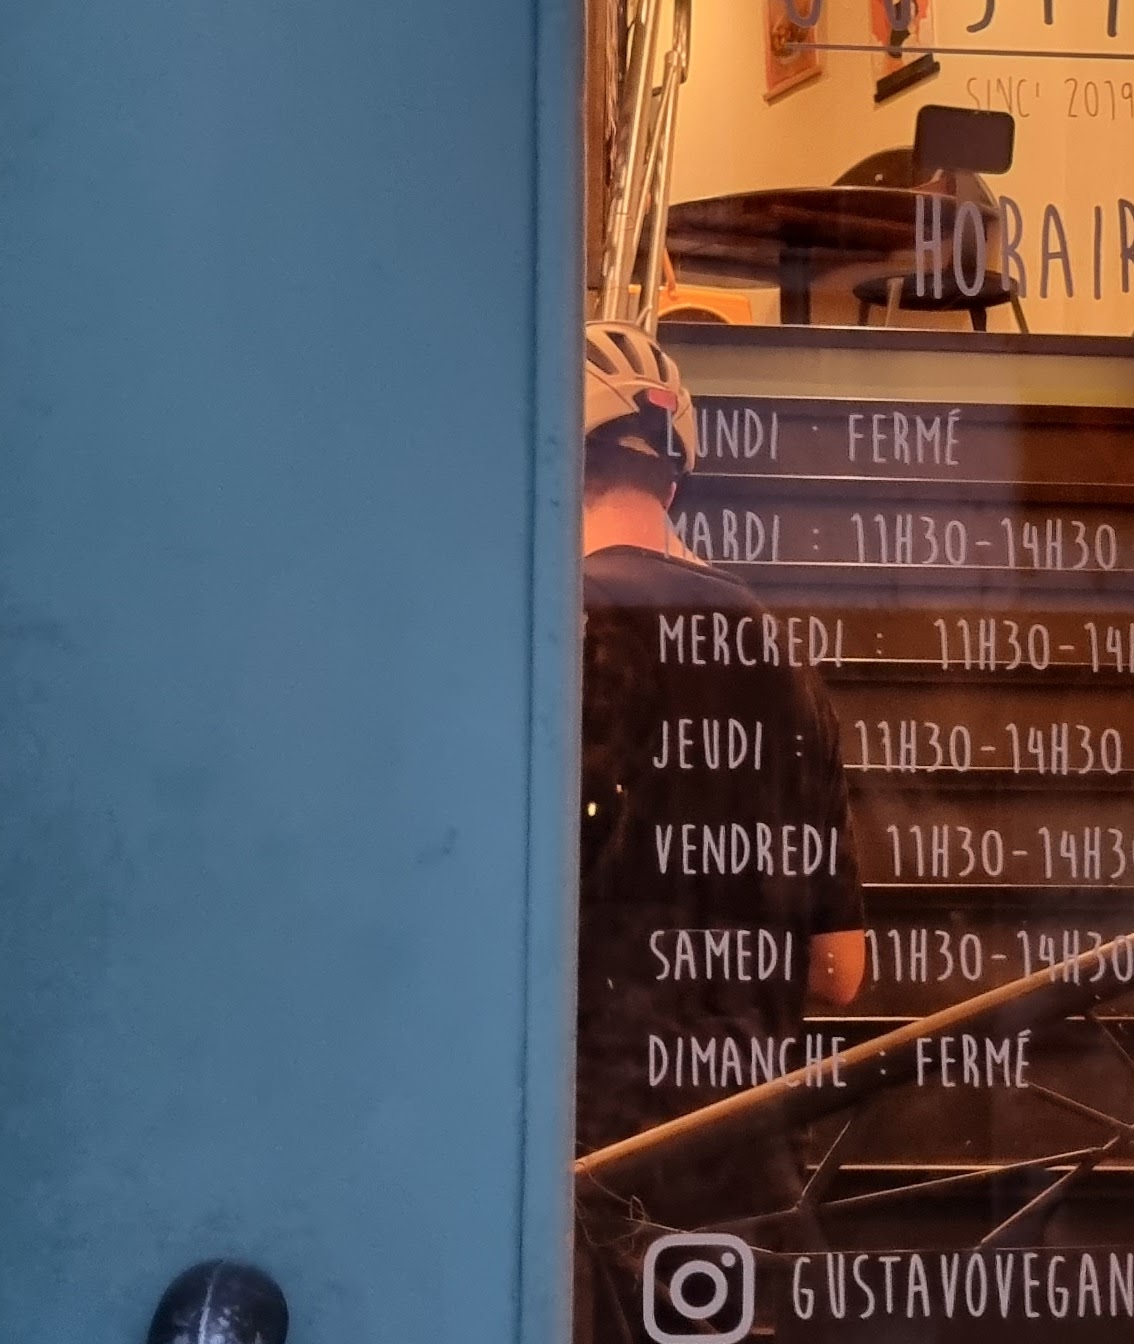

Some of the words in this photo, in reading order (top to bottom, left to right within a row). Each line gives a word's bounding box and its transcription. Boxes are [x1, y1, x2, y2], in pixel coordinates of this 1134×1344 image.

[1064, 78, 1134, 120] 2019
[666, 408, 779, 461] LUNDI
[848, 408, 962, 466] FERMÉ
[664, 509, 781, 564] MARDI
[659, 612, 843, 668] MERCREDI
[653, 718, 763, 770] JEUDI
[655, 823, 838, 877] VENDREDI
[649, 928, 793, 981] SAMEDI
[648, 1033, 848, 1089] DIMANCHE
[916, 1029, 1032, 1089] FERMÉ
